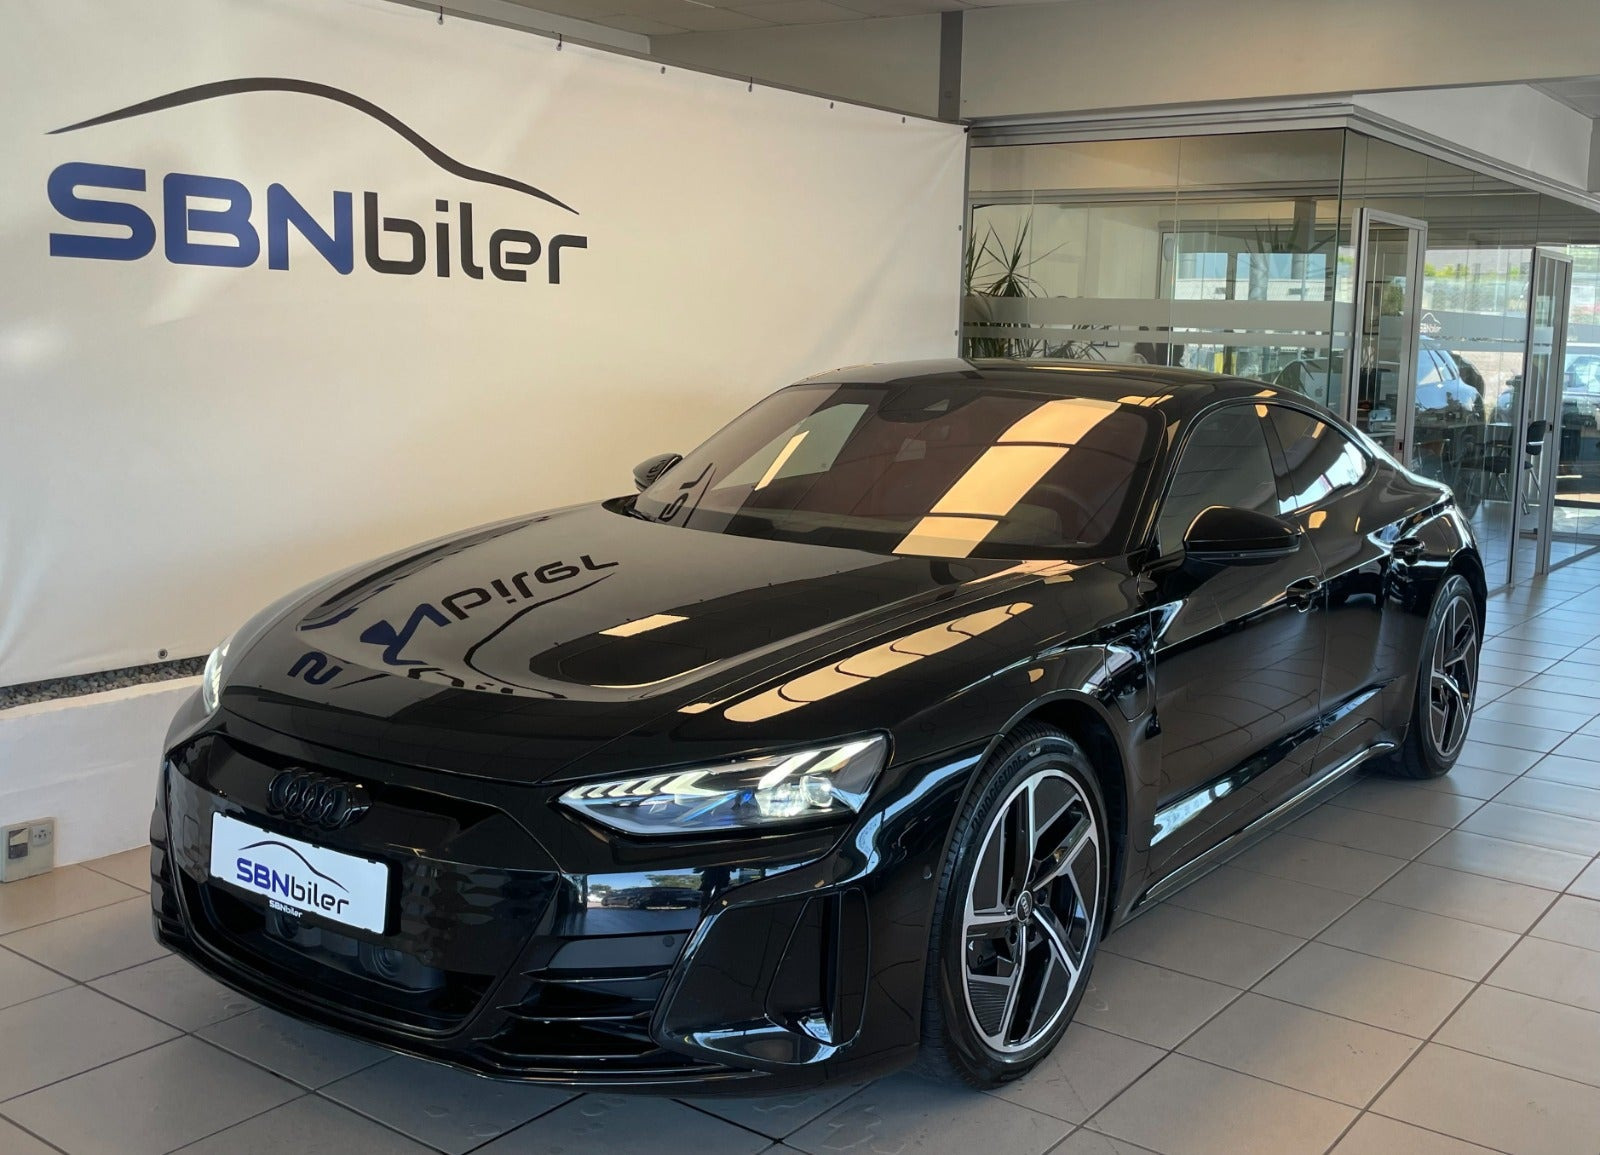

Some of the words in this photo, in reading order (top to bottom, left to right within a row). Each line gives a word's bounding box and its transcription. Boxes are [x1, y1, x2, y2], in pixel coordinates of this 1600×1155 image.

[47, 161, 588, 285] SBNbiler
[236, 857, 350, 915] SBNbiler
[268, 899, 303, 918] SBNbiler
